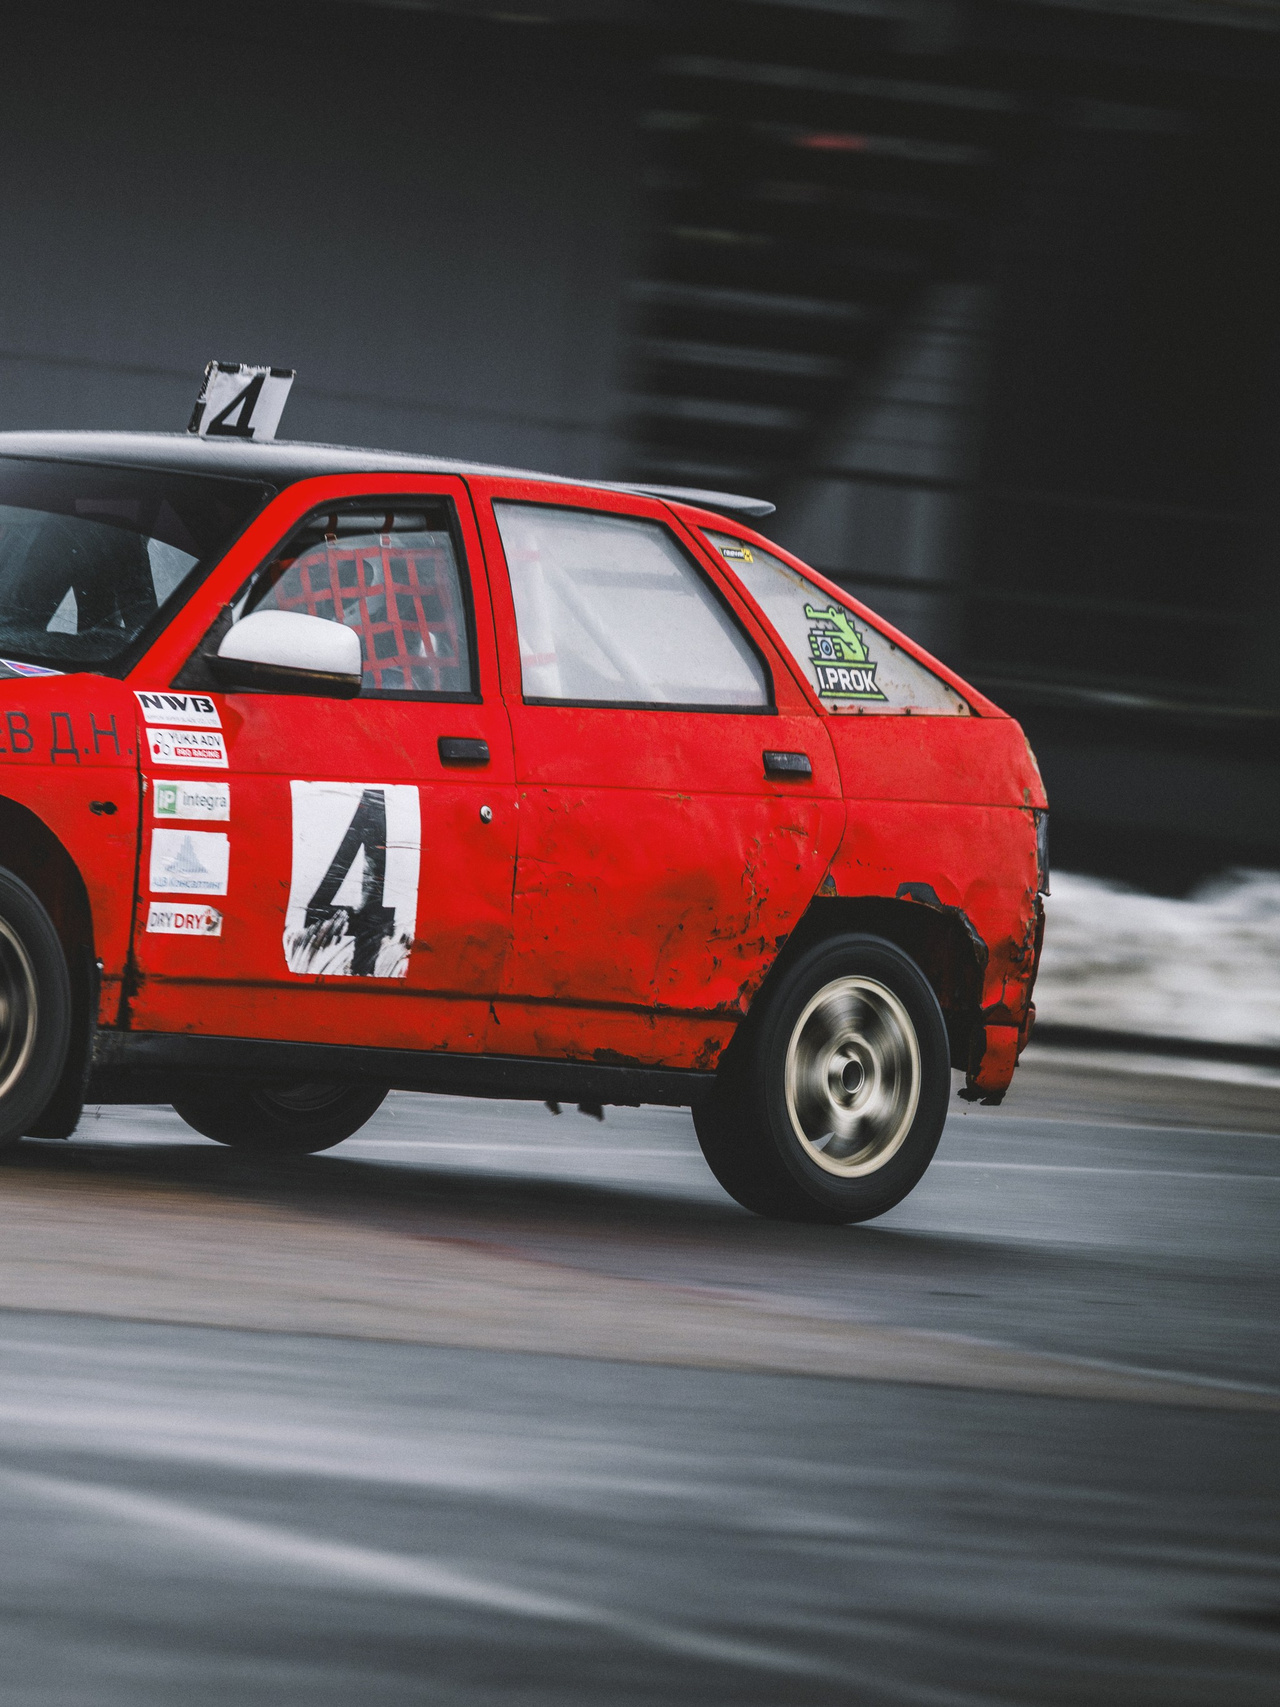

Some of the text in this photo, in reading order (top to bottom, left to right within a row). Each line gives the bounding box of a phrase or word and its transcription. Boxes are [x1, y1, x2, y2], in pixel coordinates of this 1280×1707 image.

[205, 372, 266, 438] 4
[816, 666, 878, 693] I.PROK
[138, 694, 215, 714] NWB
[168, 731, 199, 745] YUKA
[182, 791, 227, 811] integra
[303, 788, 396, 978] 4
